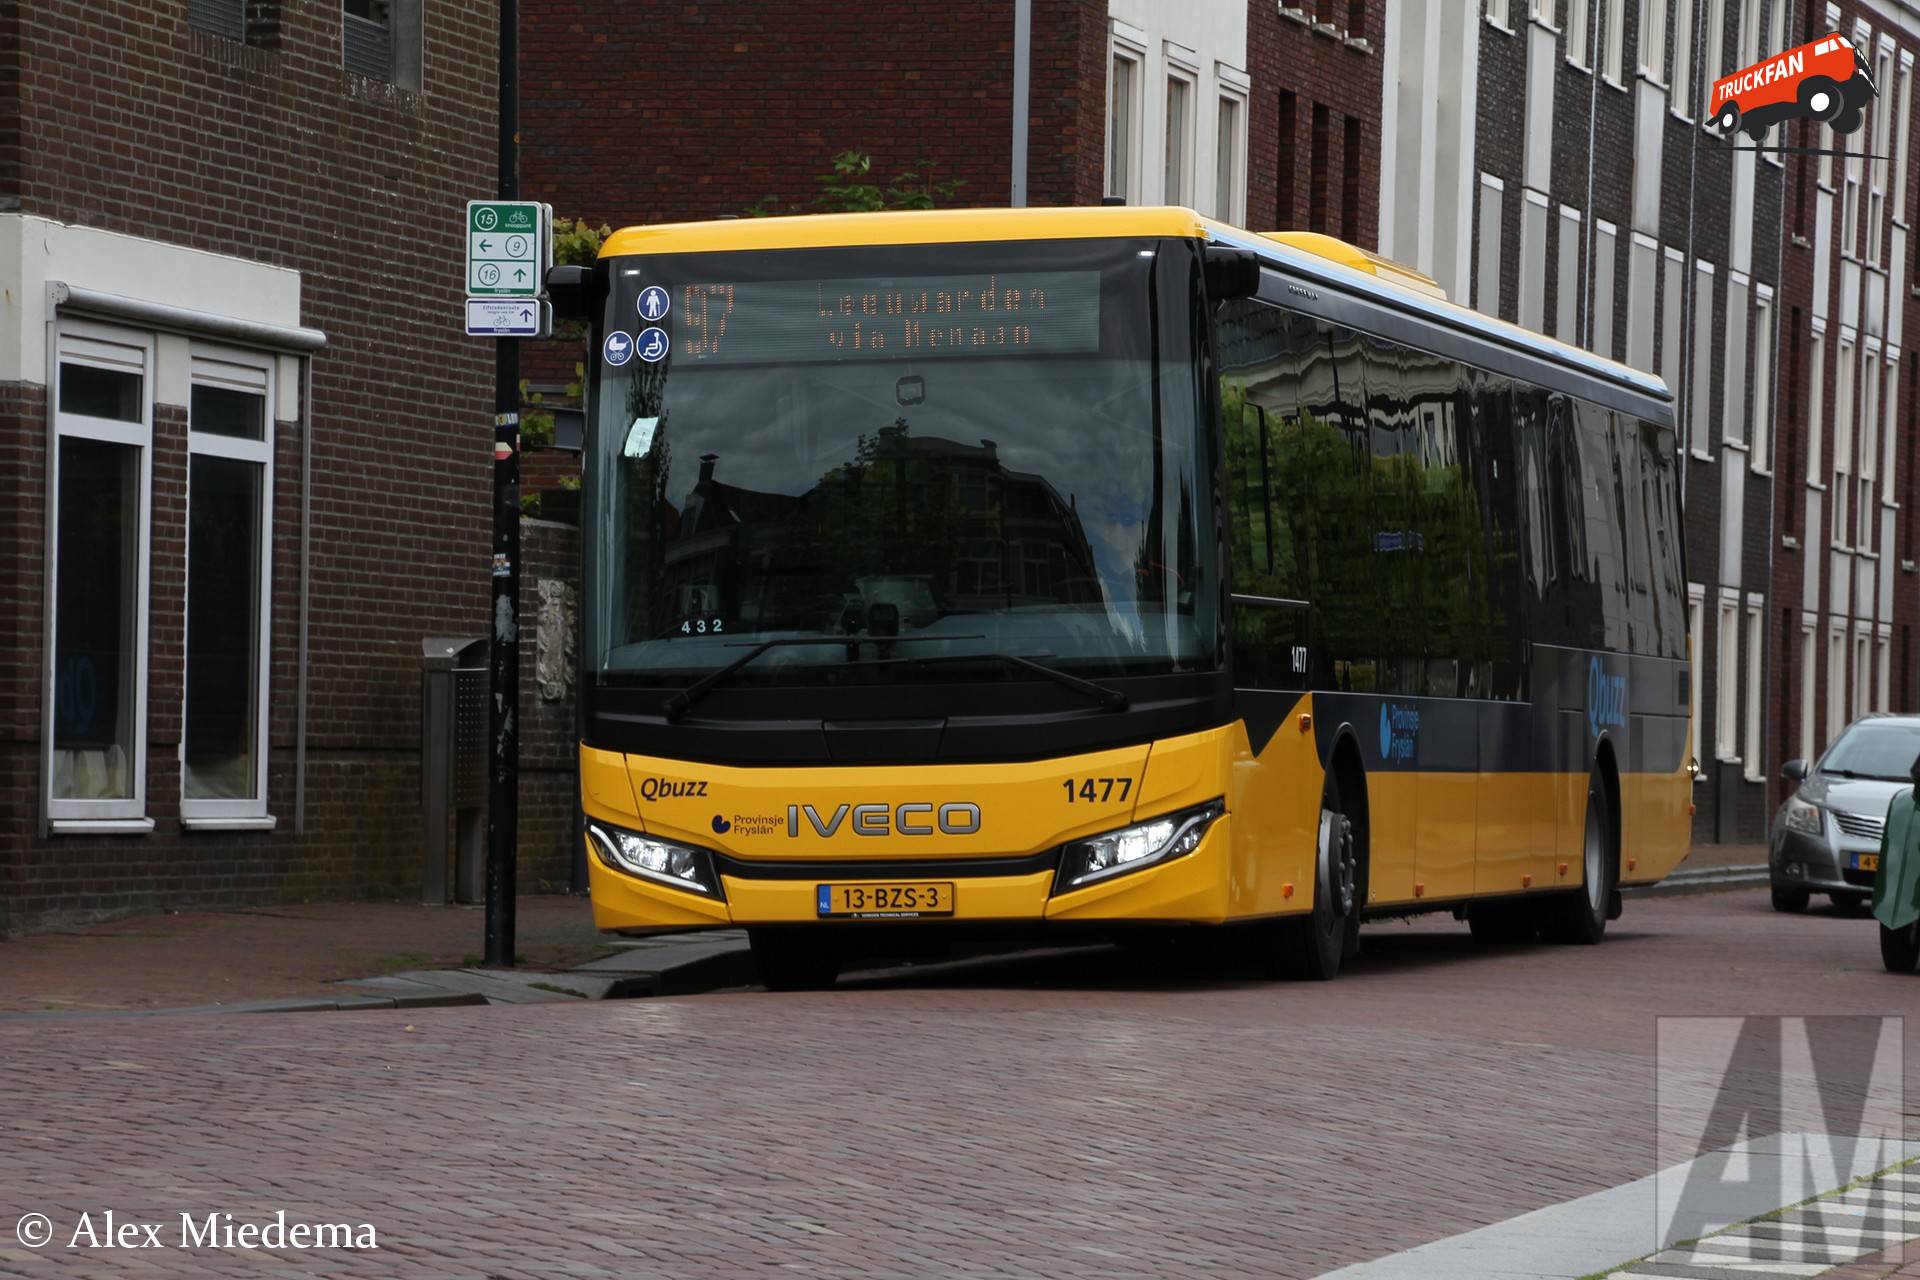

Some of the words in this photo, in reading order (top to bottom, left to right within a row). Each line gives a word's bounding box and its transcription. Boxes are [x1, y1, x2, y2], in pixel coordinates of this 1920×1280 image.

[480, 214, 494, 225] 15
[512, 241, 521, 252] 9
[484, 269, 497, 280] 16
[817, 275, 1046, 317] Leeuwarden
[829, 321, 885, 349] via
[1291, 645, 1307, 673] 1477
[1588, 655, 1626, 737] Qbuzz
[640, 777, 709, 802] Qbuzz
[1062, 777, 1133, 803] 1477
[734, 814, 784, 827] Provinsje
[734, 825, 774, 837] Fryslân
[787, 802, 981, 838] IVECO
[820, 901, 829, 909] NL
[844, 887, 939, 909] 13-BZS-3
